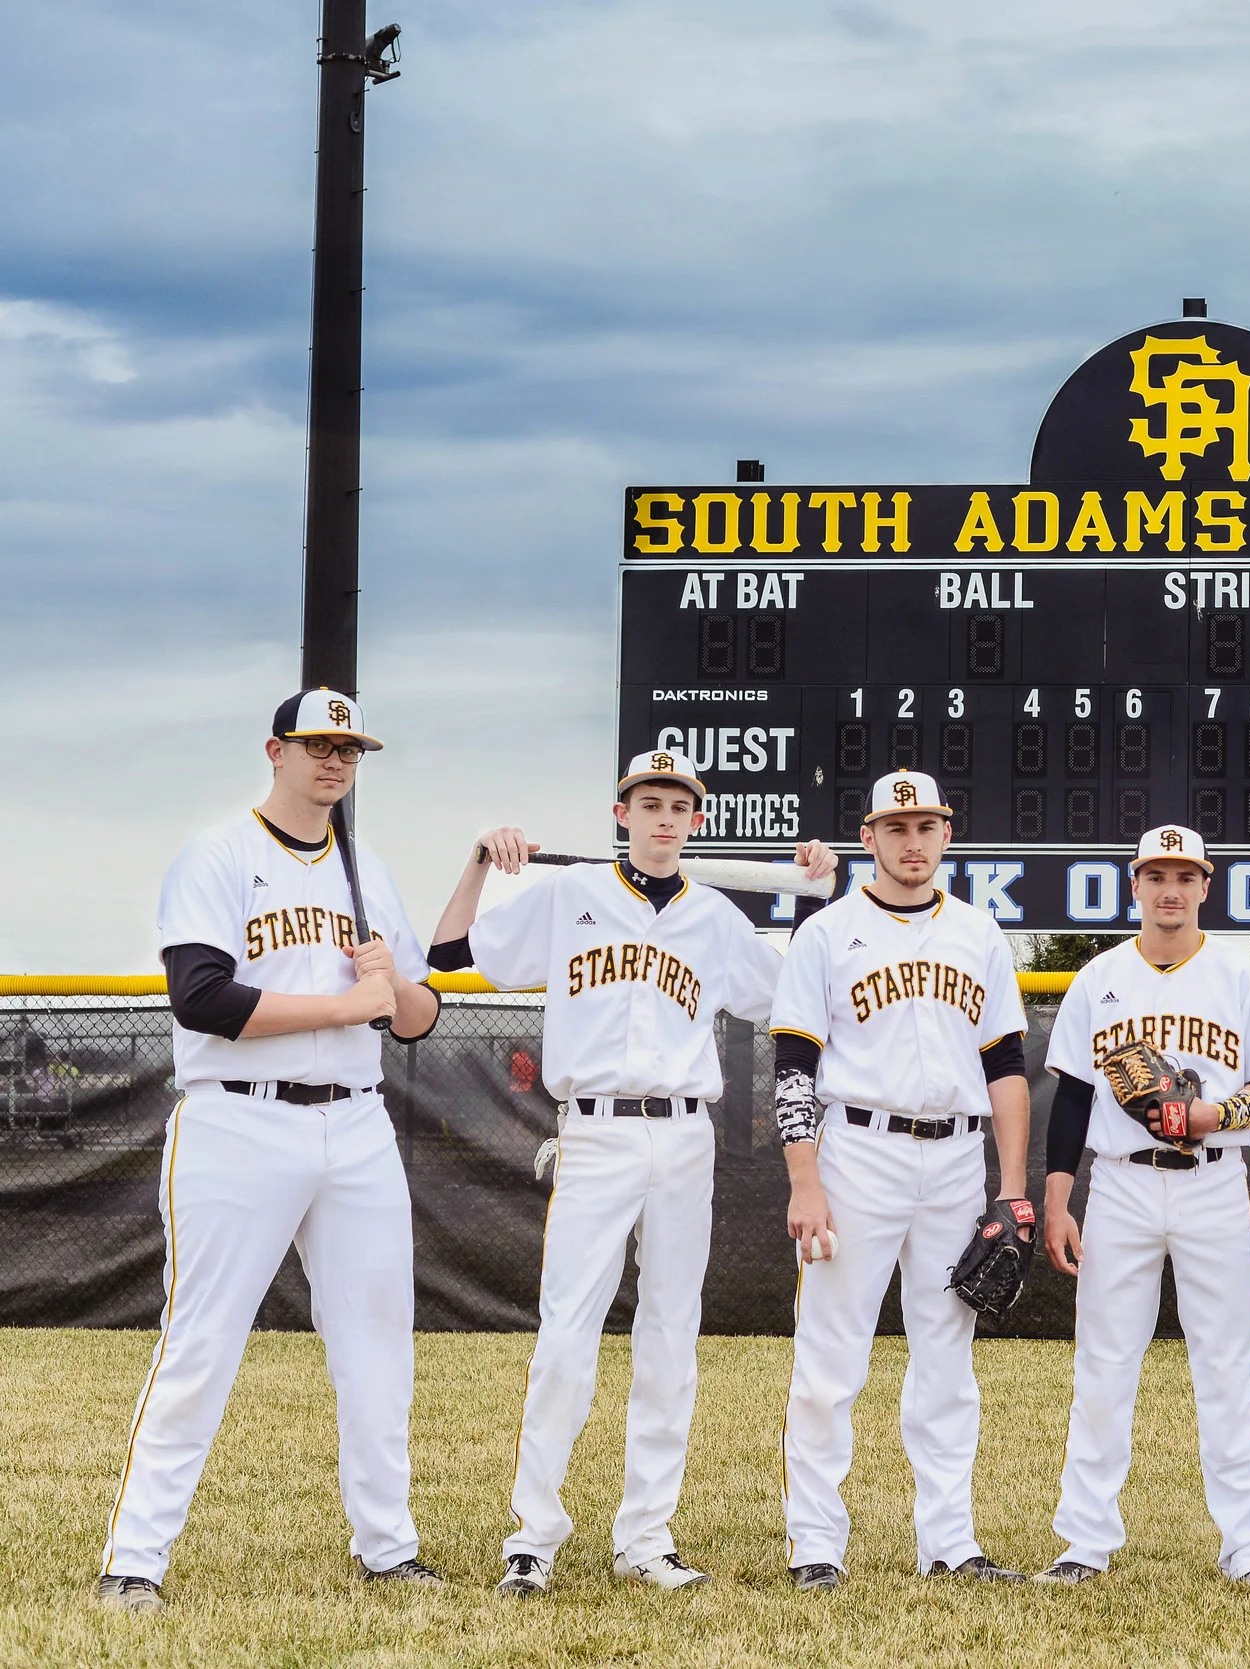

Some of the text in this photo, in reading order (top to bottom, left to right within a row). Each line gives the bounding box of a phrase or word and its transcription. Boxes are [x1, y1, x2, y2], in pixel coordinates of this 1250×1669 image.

[633, 491, 912, 554] SOUTH
[954, 490, 1246, 553] ADAMS
[679, 572, 804, 609] AT BAT
[939, 572, 1034, 609] BALL
[652, 689, 769, 701] DAKTRONICS
[851, 689, 862, 717] 1
[897, 689, 915, 718] 2
[947, 689, 965, 719] 3
[1023, 689, 1041, 718] 4
[1074, 689, 1092, 719] 5
[1126, 689, 1143, 719] 6
[1204, 689, 1221, 719] 7
[657, 727, 795, 772] GUEST
[691, 794, 800, 837] RFIRES
[246, 907, 384, 961] STARFIR
[568, 944, 701, 1021] STARFIRES
[851, 960, 985, 1026] STARFIRES
[1093, 1014, 1240, 1073] STARFIRES
